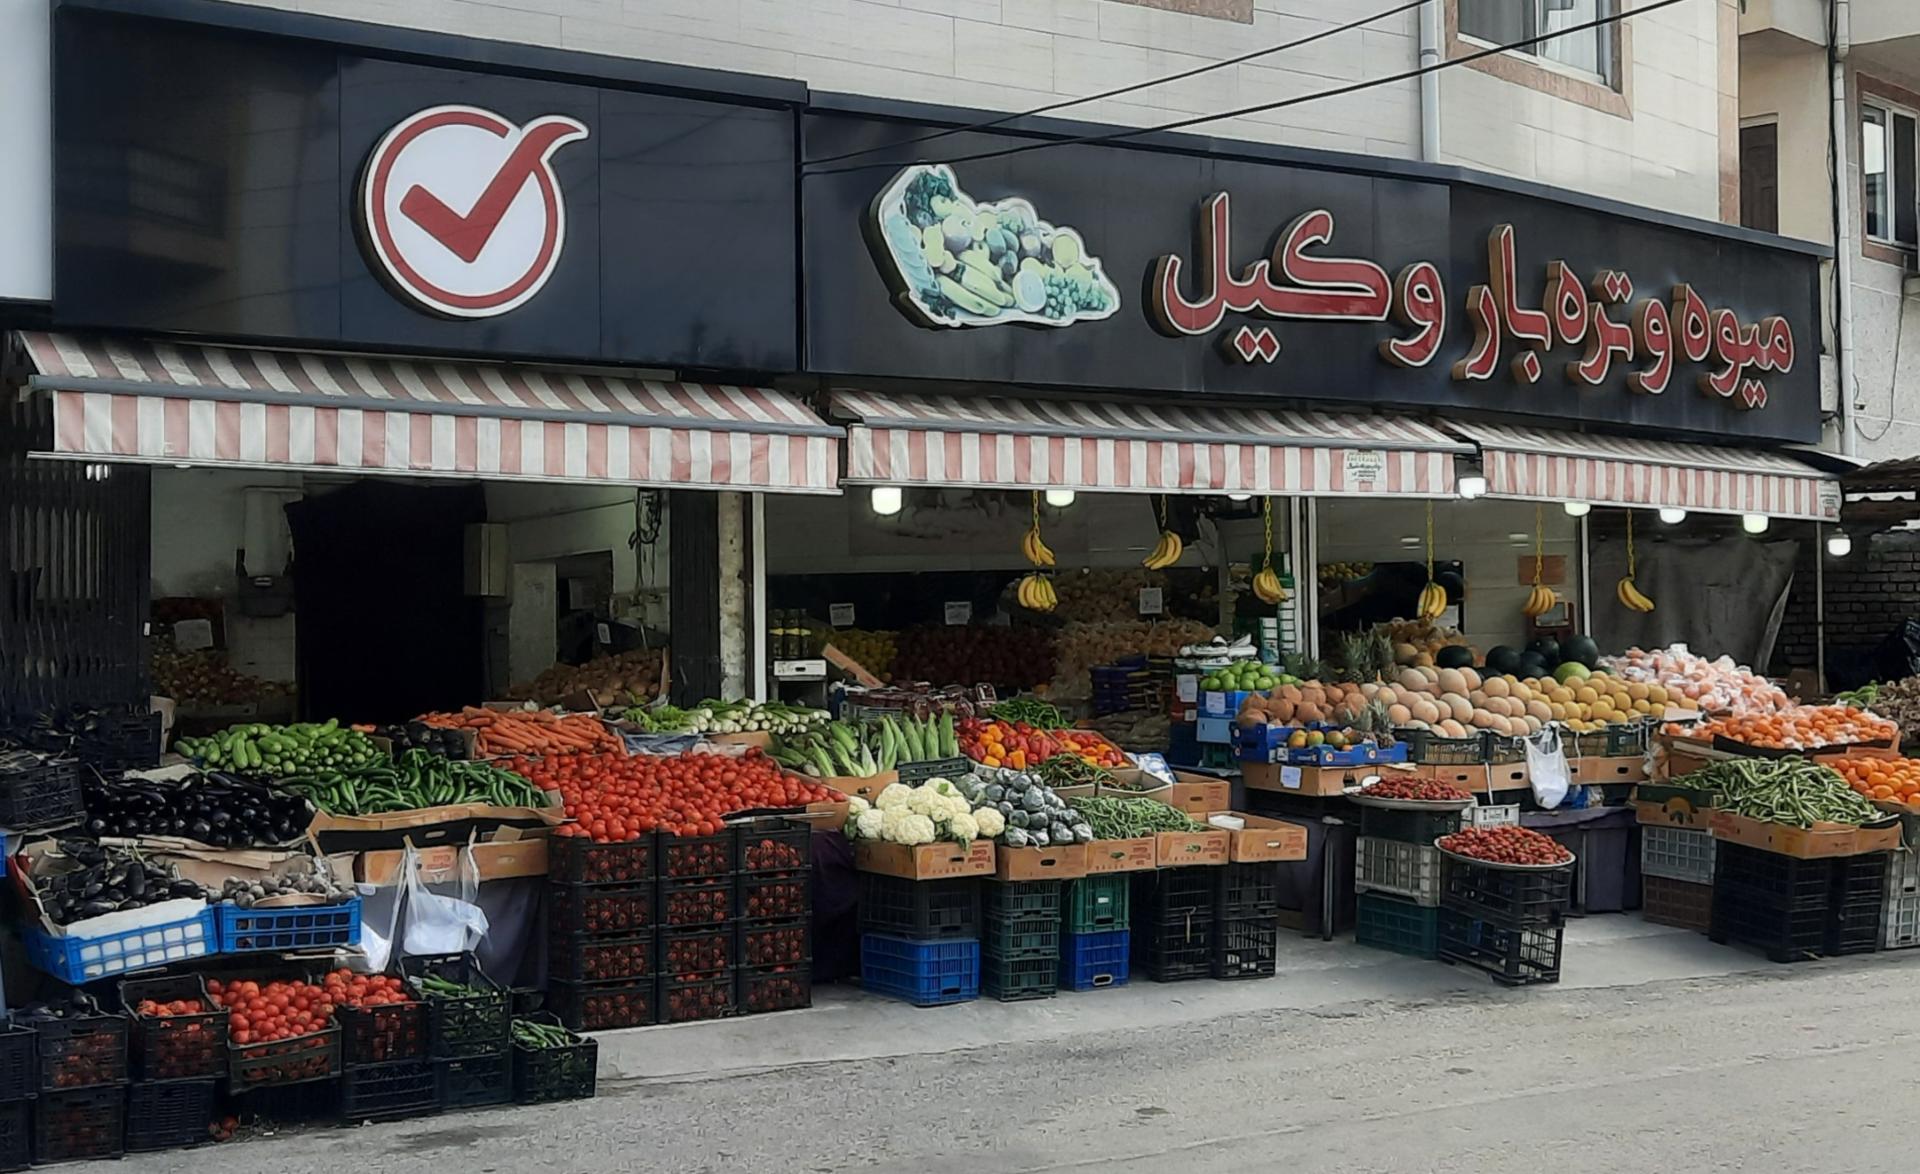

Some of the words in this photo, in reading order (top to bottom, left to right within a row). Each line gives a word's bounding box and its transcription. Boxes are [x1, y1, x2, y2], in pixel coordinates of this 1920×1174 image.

[1160, 190, 1446, 367] وکیل
[1637, 297, 1674, 395] و
[1680, 283, 1795, 410] میوه
